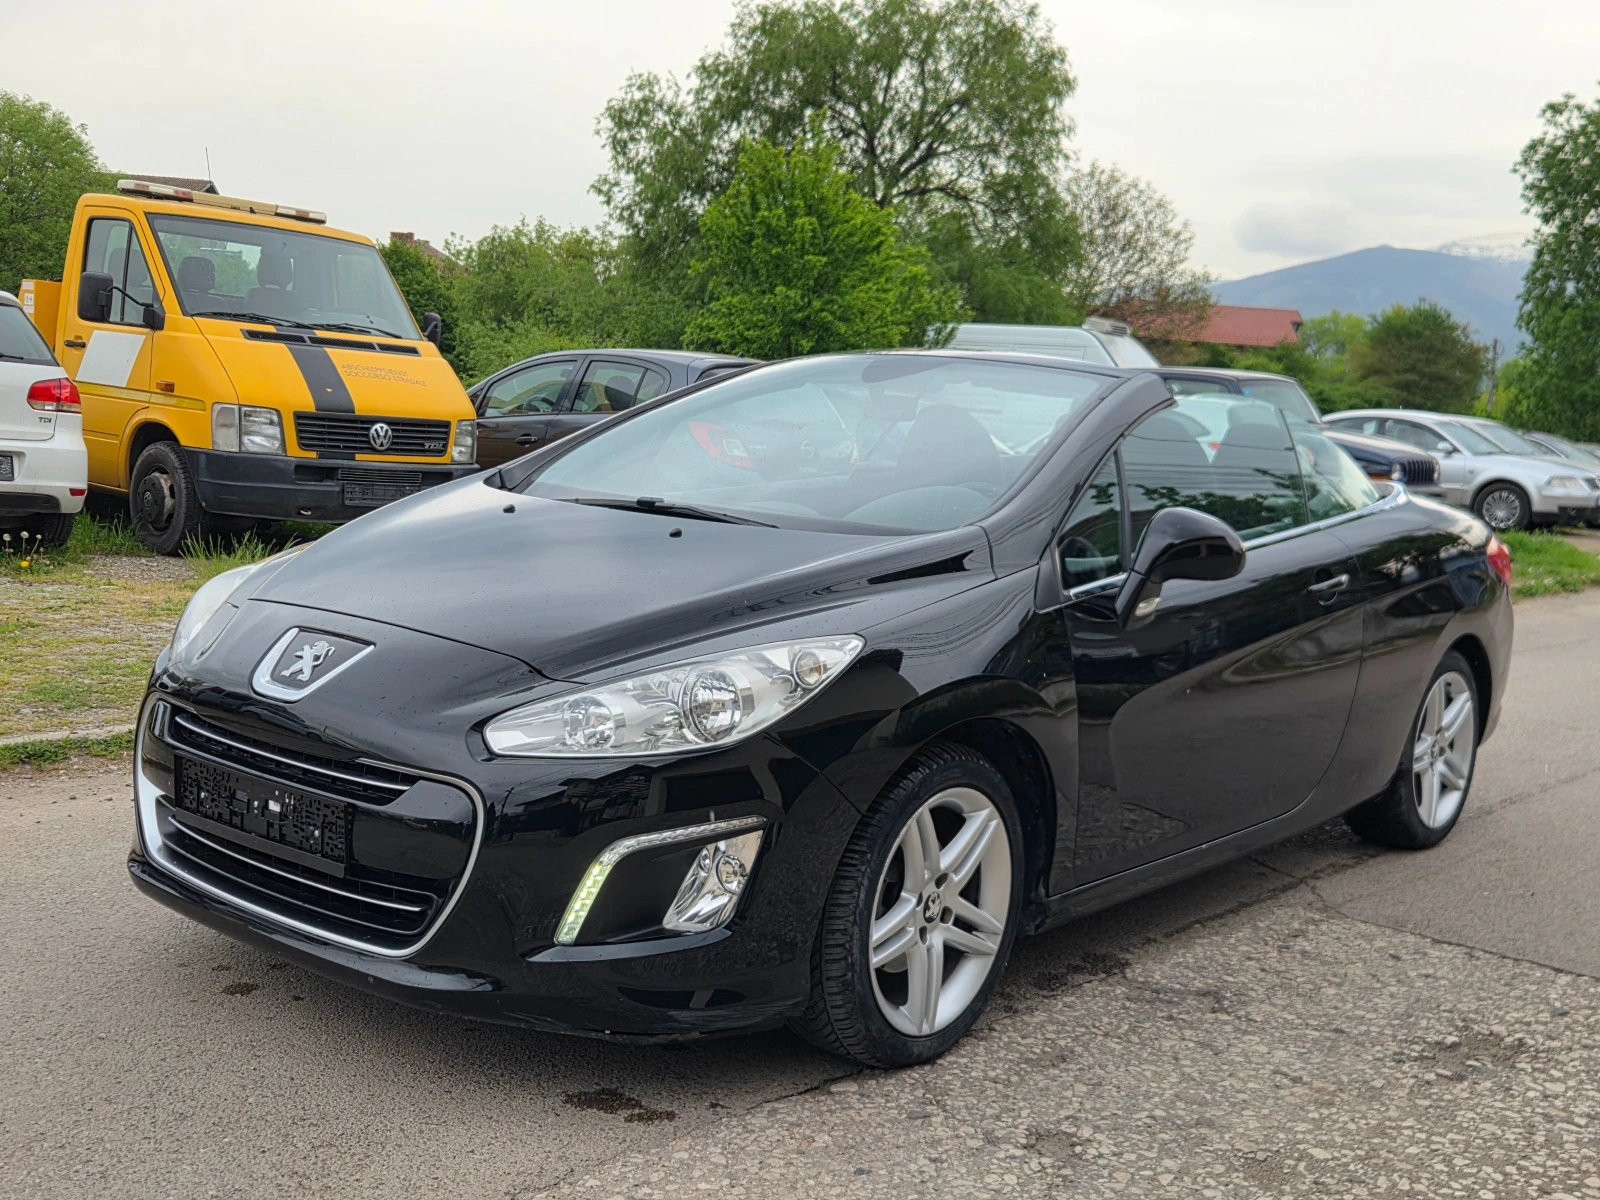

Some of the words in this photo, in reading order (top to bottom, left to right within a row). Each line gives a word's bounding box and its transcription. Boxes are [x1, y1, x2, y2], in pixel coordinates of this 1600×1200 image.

[344, 370, 392, 381] SOCCORSO
[38, 416, 52, 424] TDI
[424, 442, 445, 450] TDI
